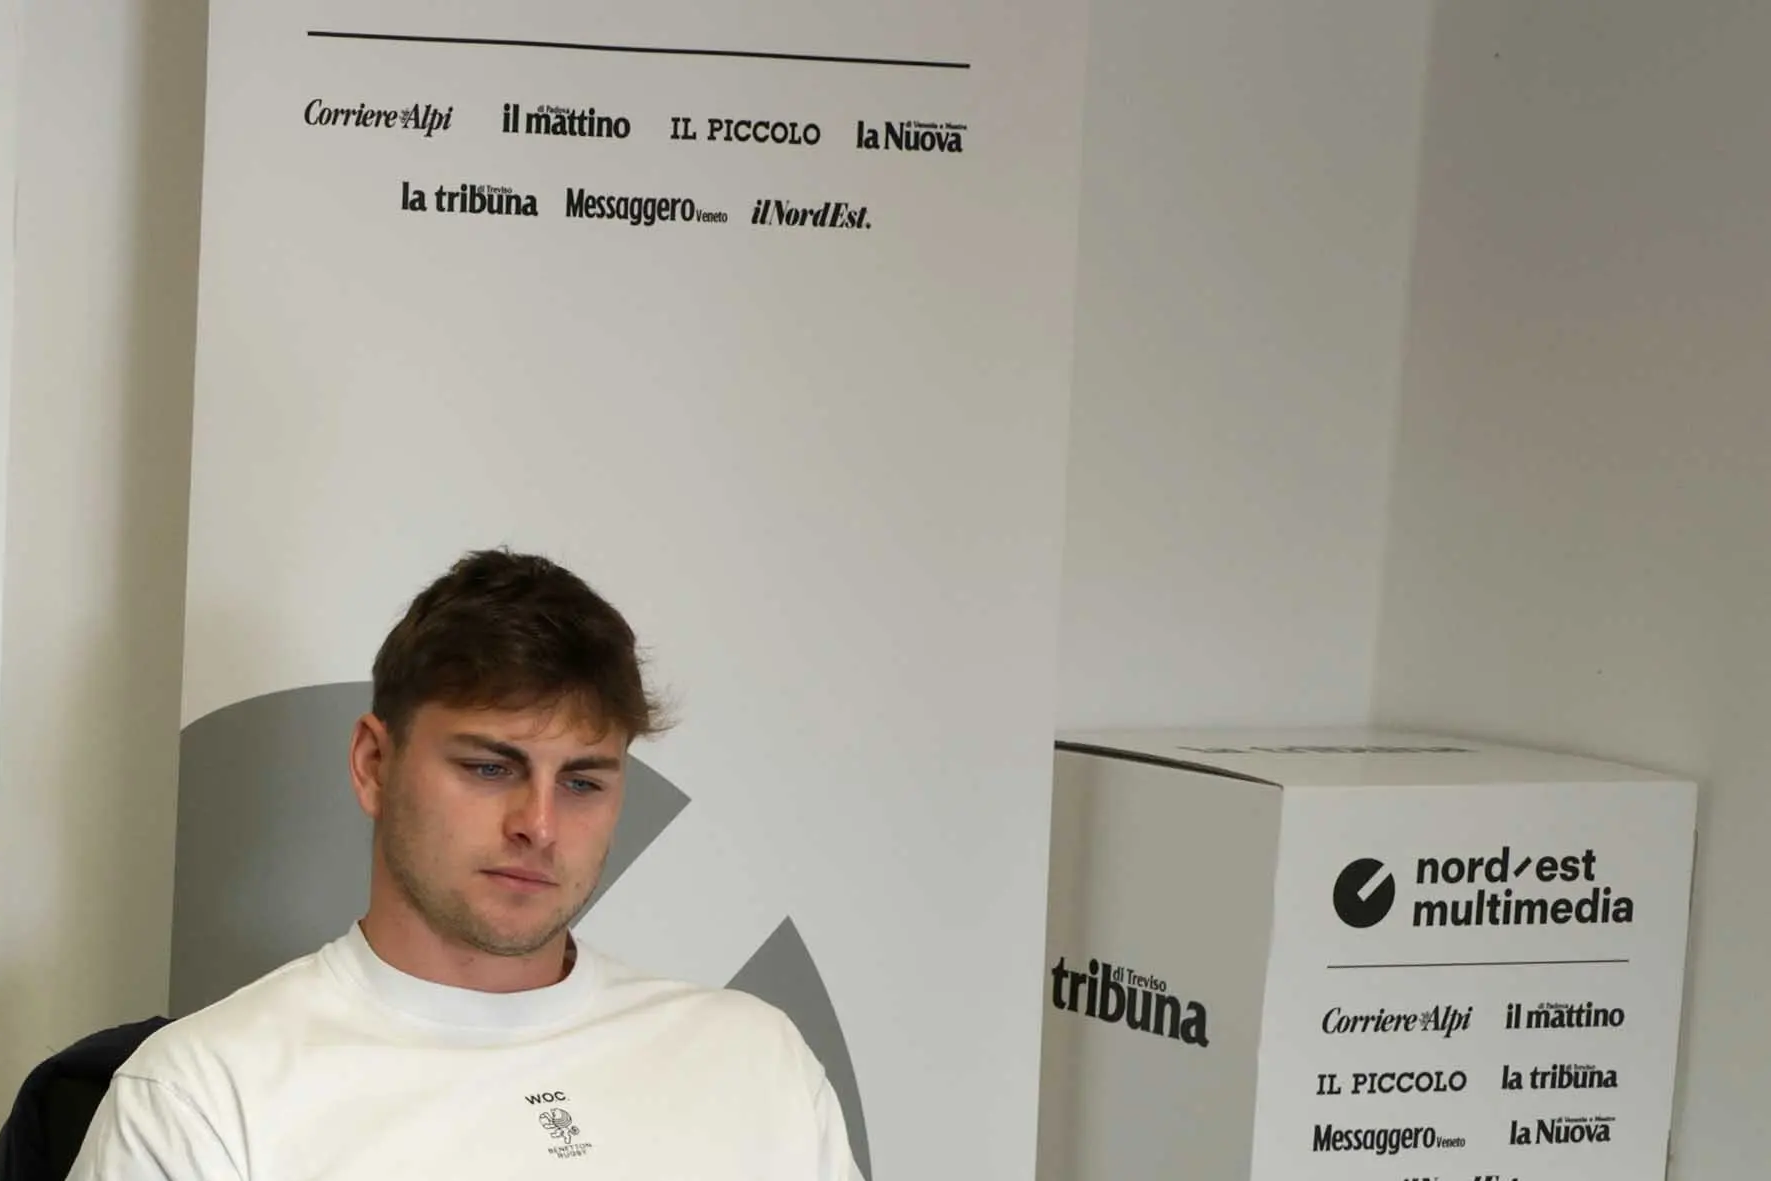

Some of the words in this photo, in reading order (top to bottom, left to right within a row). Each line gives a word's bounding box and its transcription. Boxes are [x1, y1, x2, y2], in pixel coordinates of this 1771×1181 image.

[304, 98, 398, 128] Corriere
[403, 103, 453, 137] Alpi
[503, 103, 519, 133] il
[526, 107, 630, 138] mattino
[671, 117, 696, 140] IL
[707, 118, 820, 145] PICCOLO
[857, 121, 879, 150] la
[884, 121, 964, 152] Nuova
[401, 182, 427, 212] la
[435, 184, 538, 216] tribuna
[565, 187, 695, 226] Messaggero
[696, 209, 728, 223] Veneto
[1413, 886, 1634, 928] multimedia
[1113, 965, 1124, 982] di
[1127, 968, 1168, 993] Treviso
[1051, 956, 1210, 1048] tribuna
[1506, 1003, 1521, 1029] il
[1526, 1002, 1625, 1029] mattino
[1322, 1007, 1418, 1034] Corriere
[1422, 1004, 1474, 1038] Alpi
[1317, 1074, 1341, 1095] IL
[1352, 1070, 1467, 1094] PICCOLO
[1501, 1065, 1523, 1090] la
[1530, 1064, 1618, 1090] tribuna
[525, 1091, 566, 1105] WOC
[1313, 1124, 1436, 1155] Messaggero
[1436, 1136, 1466, 1149] Veneto
[1509, 1120, 1531, 1145] la
[1536, 1119, 1611, 1145] Nuova
